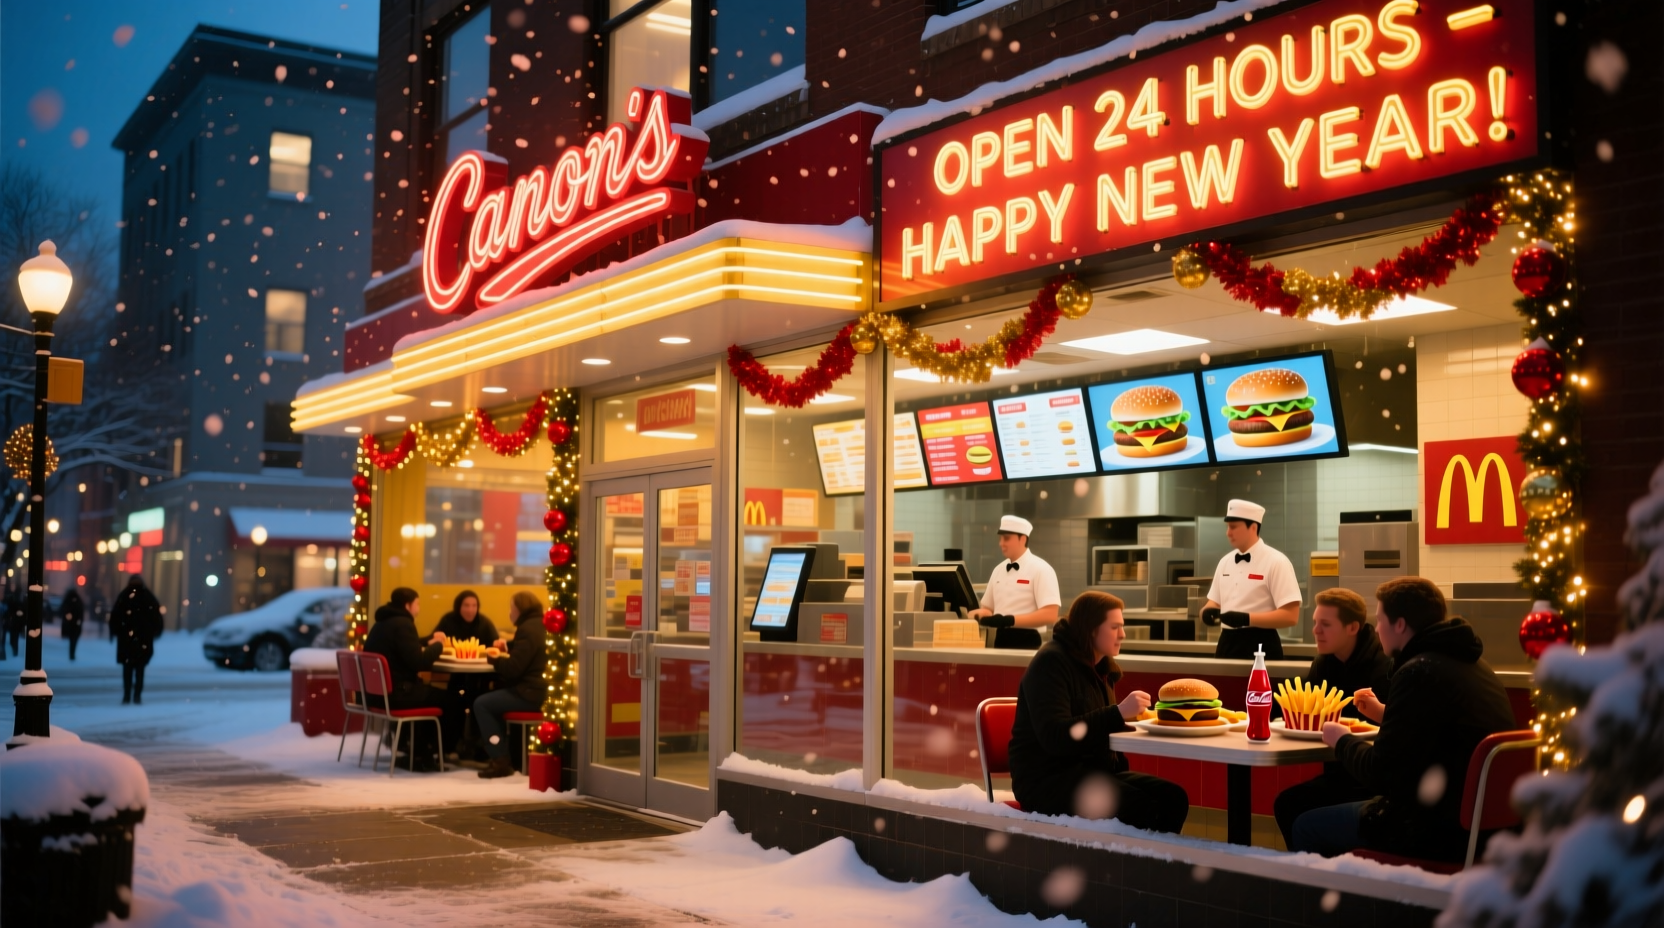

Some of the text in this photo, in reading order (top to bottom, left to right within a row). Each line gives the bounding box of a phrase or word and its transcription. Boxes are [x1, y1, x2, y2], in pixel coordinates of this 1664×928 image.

[422, 86, 683, 314] Canon's
[901, 66, 1508, 281] HAPPY NEW YEAR!
[932, 104, 1074, 196] OPEN
[1093, 77, 1166, 153] 24
[1185, 0, 1422, 126] HOURS
